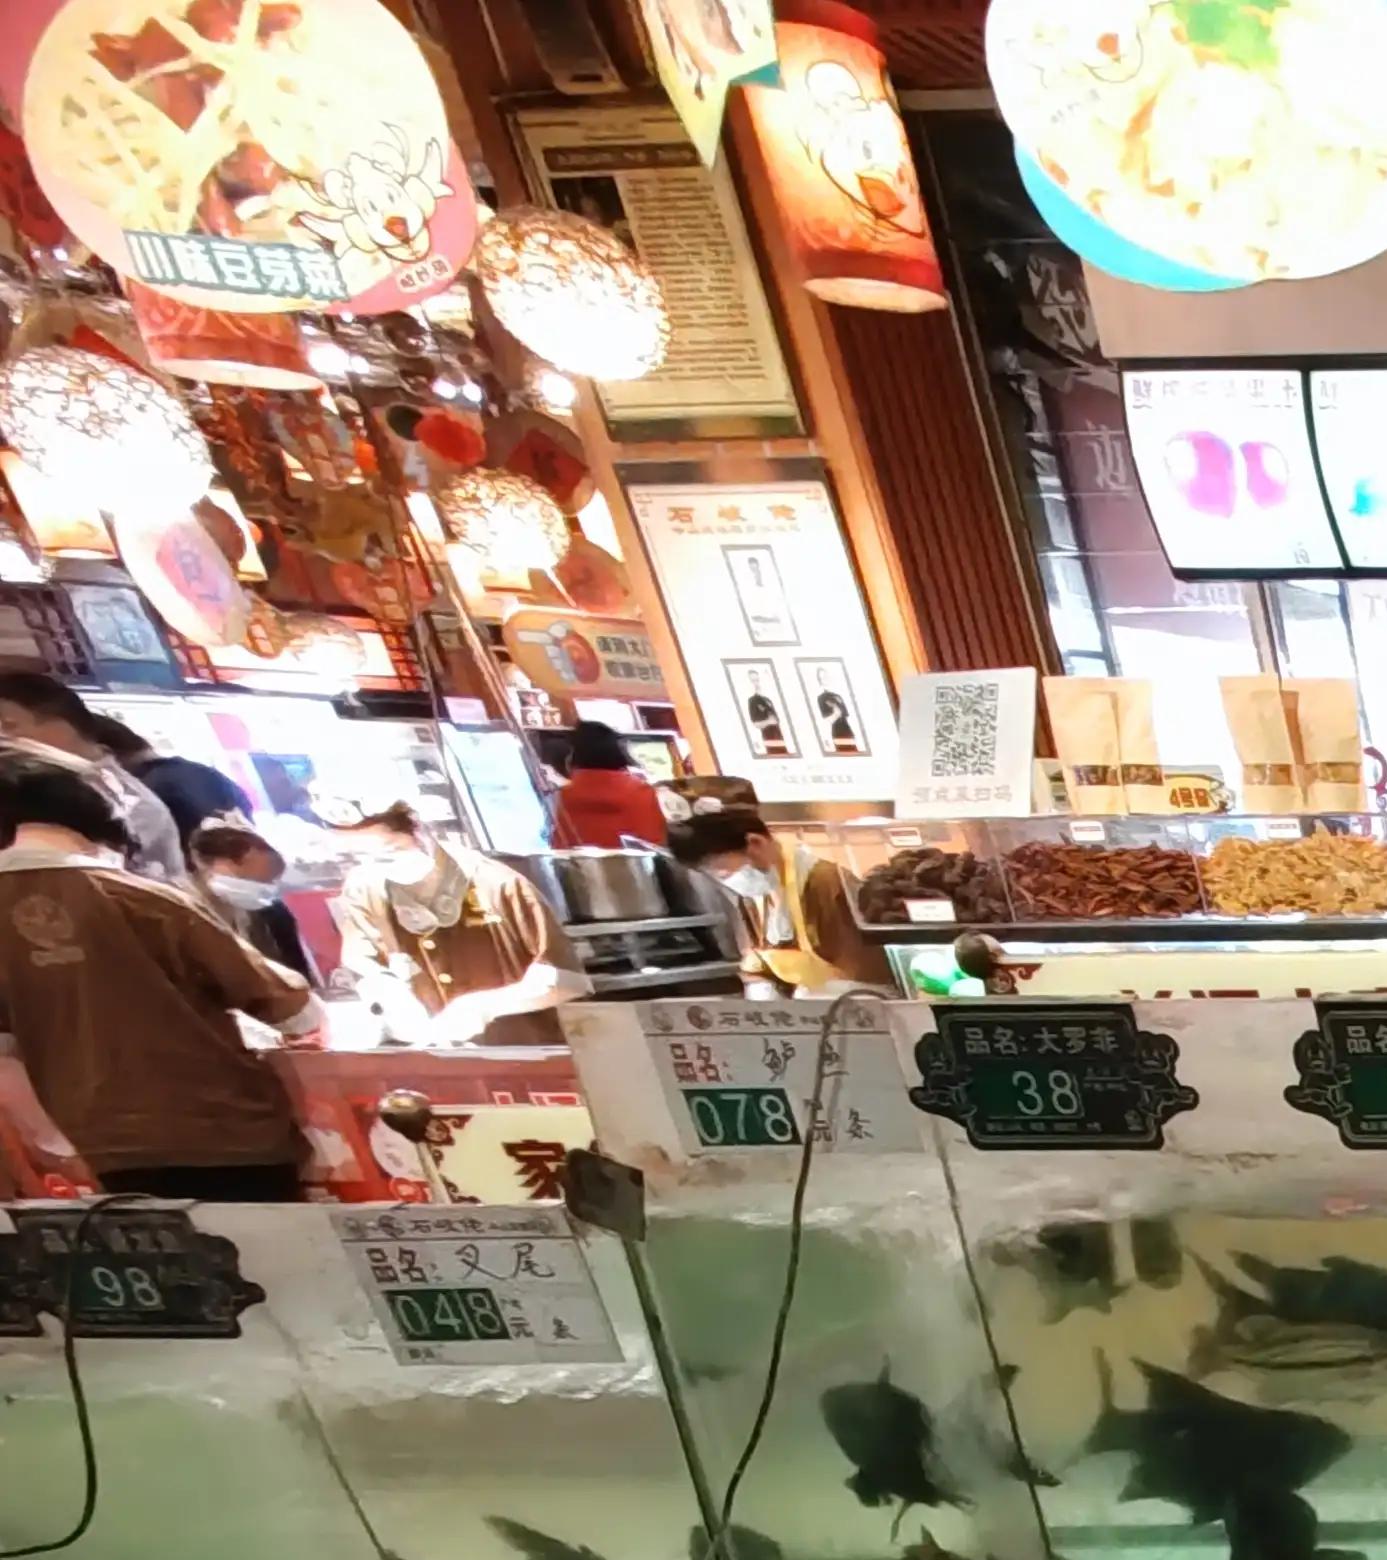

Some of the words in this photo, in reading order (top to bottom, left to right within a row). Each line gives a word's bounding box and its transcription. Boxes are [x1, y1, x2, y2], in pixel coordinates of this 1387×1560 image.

[1012, 1069, 1078, 1115] 38
[692, 1093, 792, 1143] 078
[91, 1266, 162, 1307] 98
[394, 1293, 502, 1338] 048
